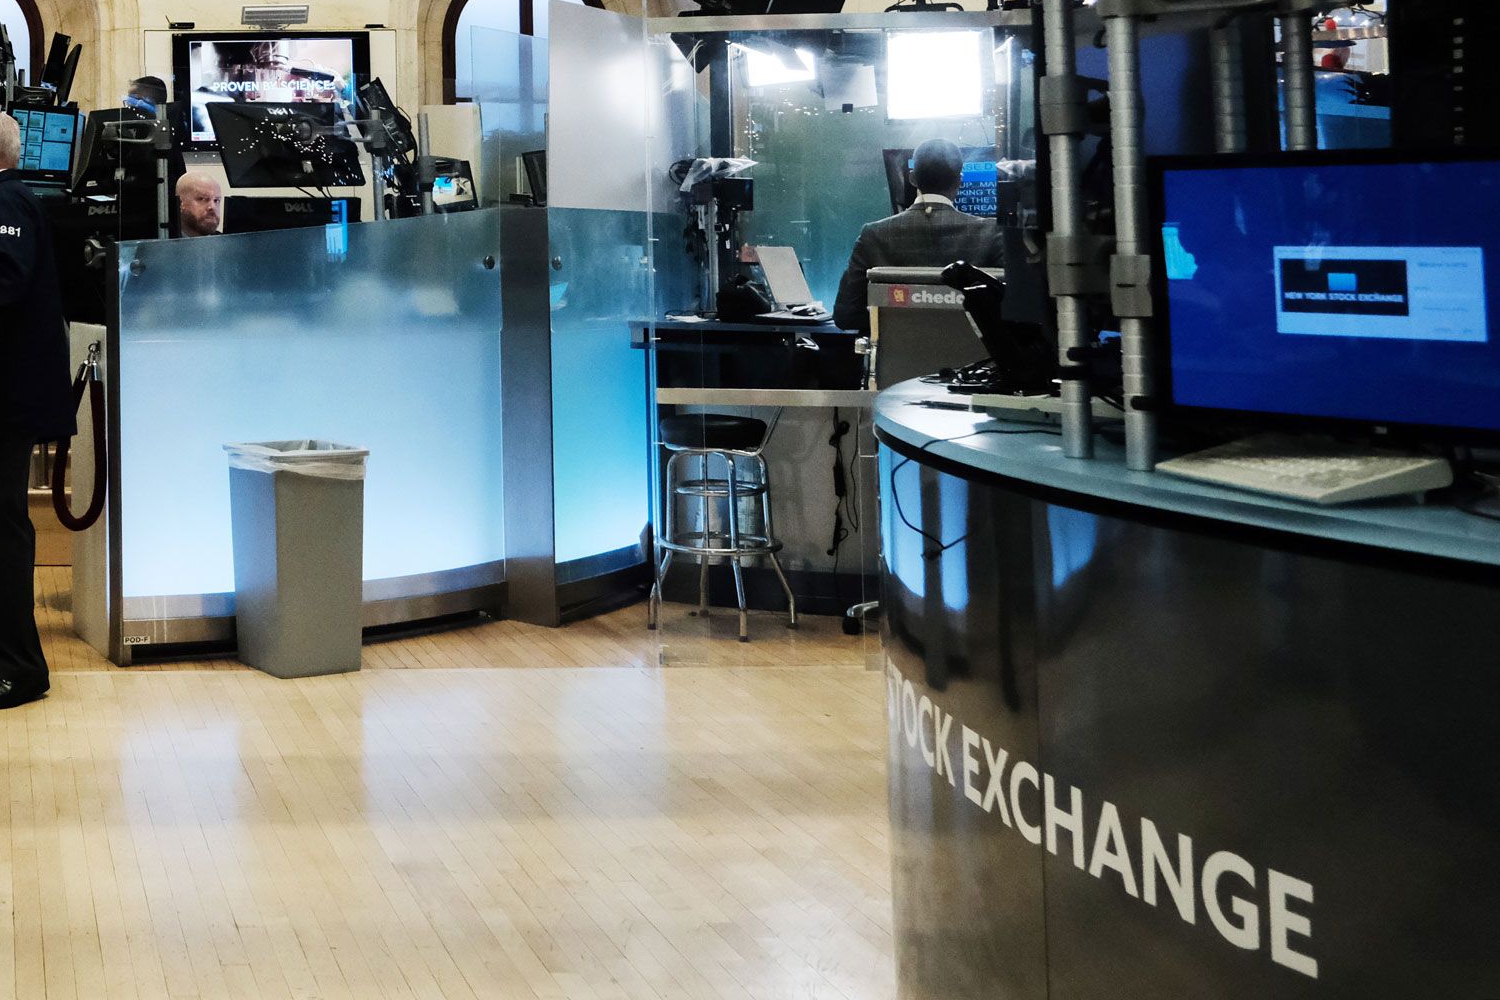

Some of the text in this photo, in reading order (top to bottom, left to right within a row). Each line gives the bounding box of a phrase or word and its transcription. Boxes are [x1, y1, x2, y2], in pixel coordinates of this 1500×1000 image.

[213, 81, 259, 92] PROVEN
[88, 205, 117, 216] DELL
[962, 723, 1318, 979] EXCHANGE
